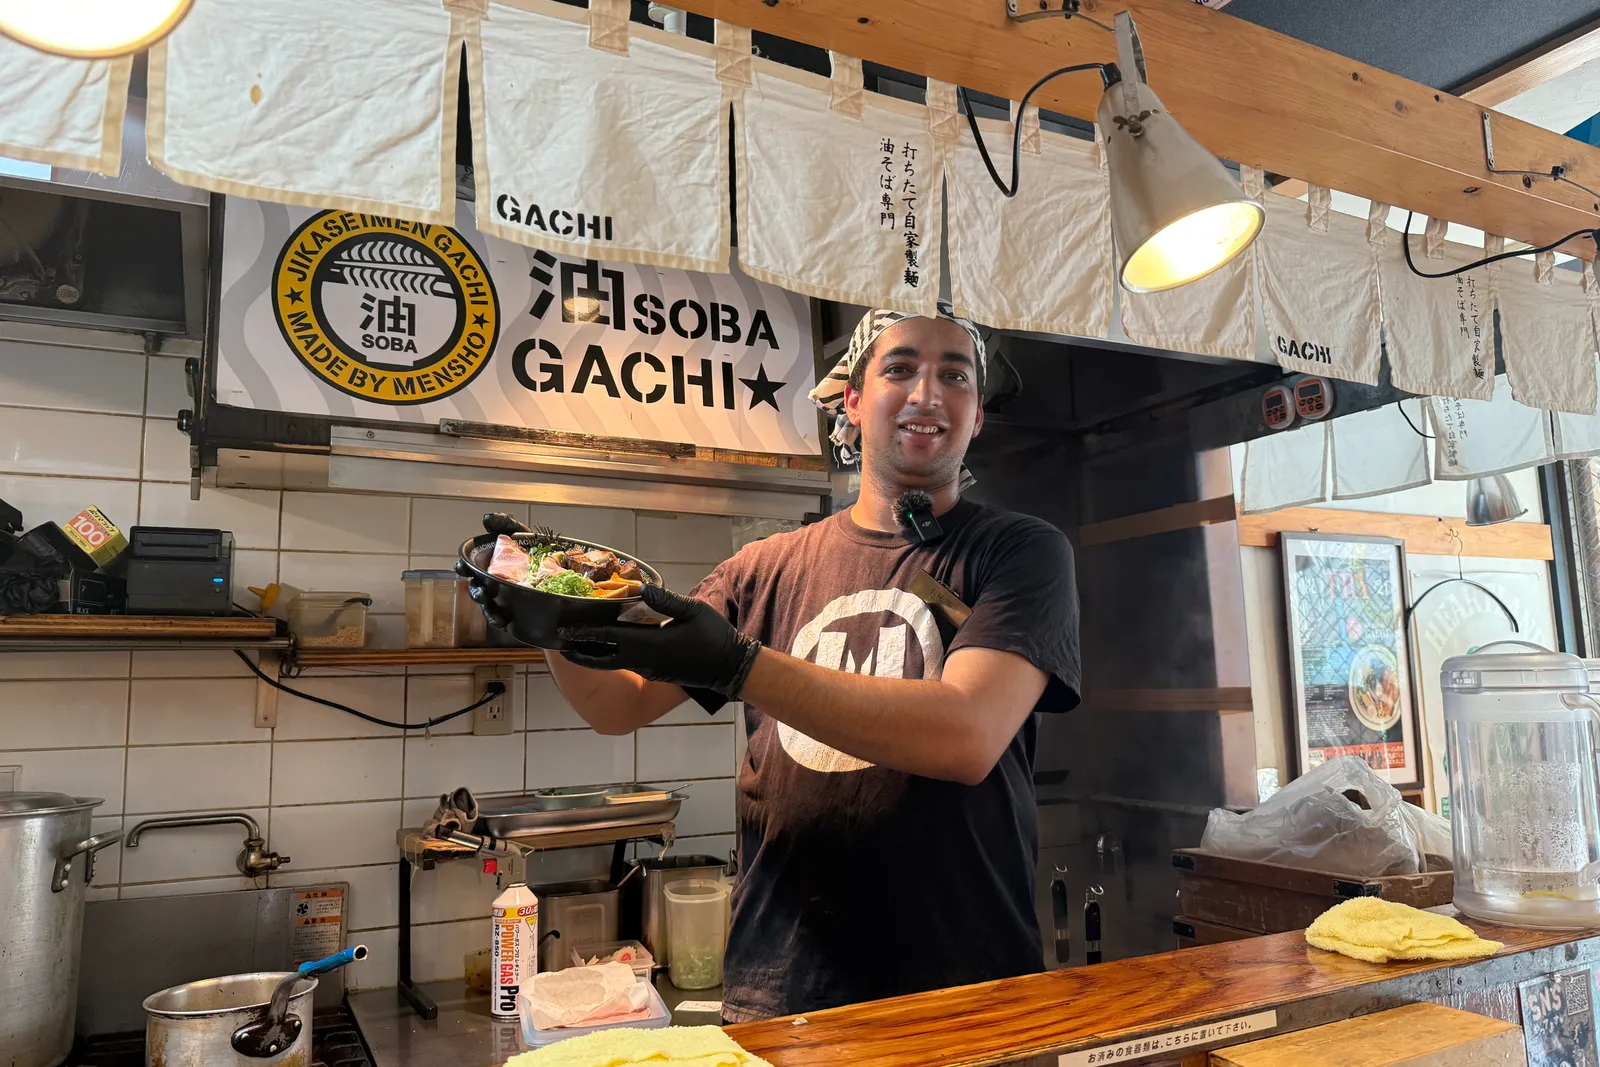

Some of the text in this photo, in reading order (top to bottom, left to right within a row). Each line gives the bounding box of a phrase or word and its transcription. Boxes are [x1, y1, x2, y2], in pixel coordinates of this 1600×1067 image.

[880, 138, 896, 230] 油そば専門
[496, 194, 613, 241] GACHI
[287, 212, 489, 305] JIKASEIMEN GACHI
[359, 292, 417, 337] 油
[1455, 273, 1470, 339] 油そば専門
[287, 310, 487, 396] MADE BY MENSHO
[361, 333, 419, 354] SOBA
[1277, 335, 1332, 365] GACHI
[511, 338, 736, 410] GACHI
[75, 514, 106, 546] 100
[500, 924, 515, 962] POWER
[500, 963, 514, 985] GAS
[500, 985, 520, 1012] Pro
[1527, 982, 1562, 1021] SNS
[1088, 1021, 1252, 1063] お済みの食器類は、こちらに置いて下さい。
